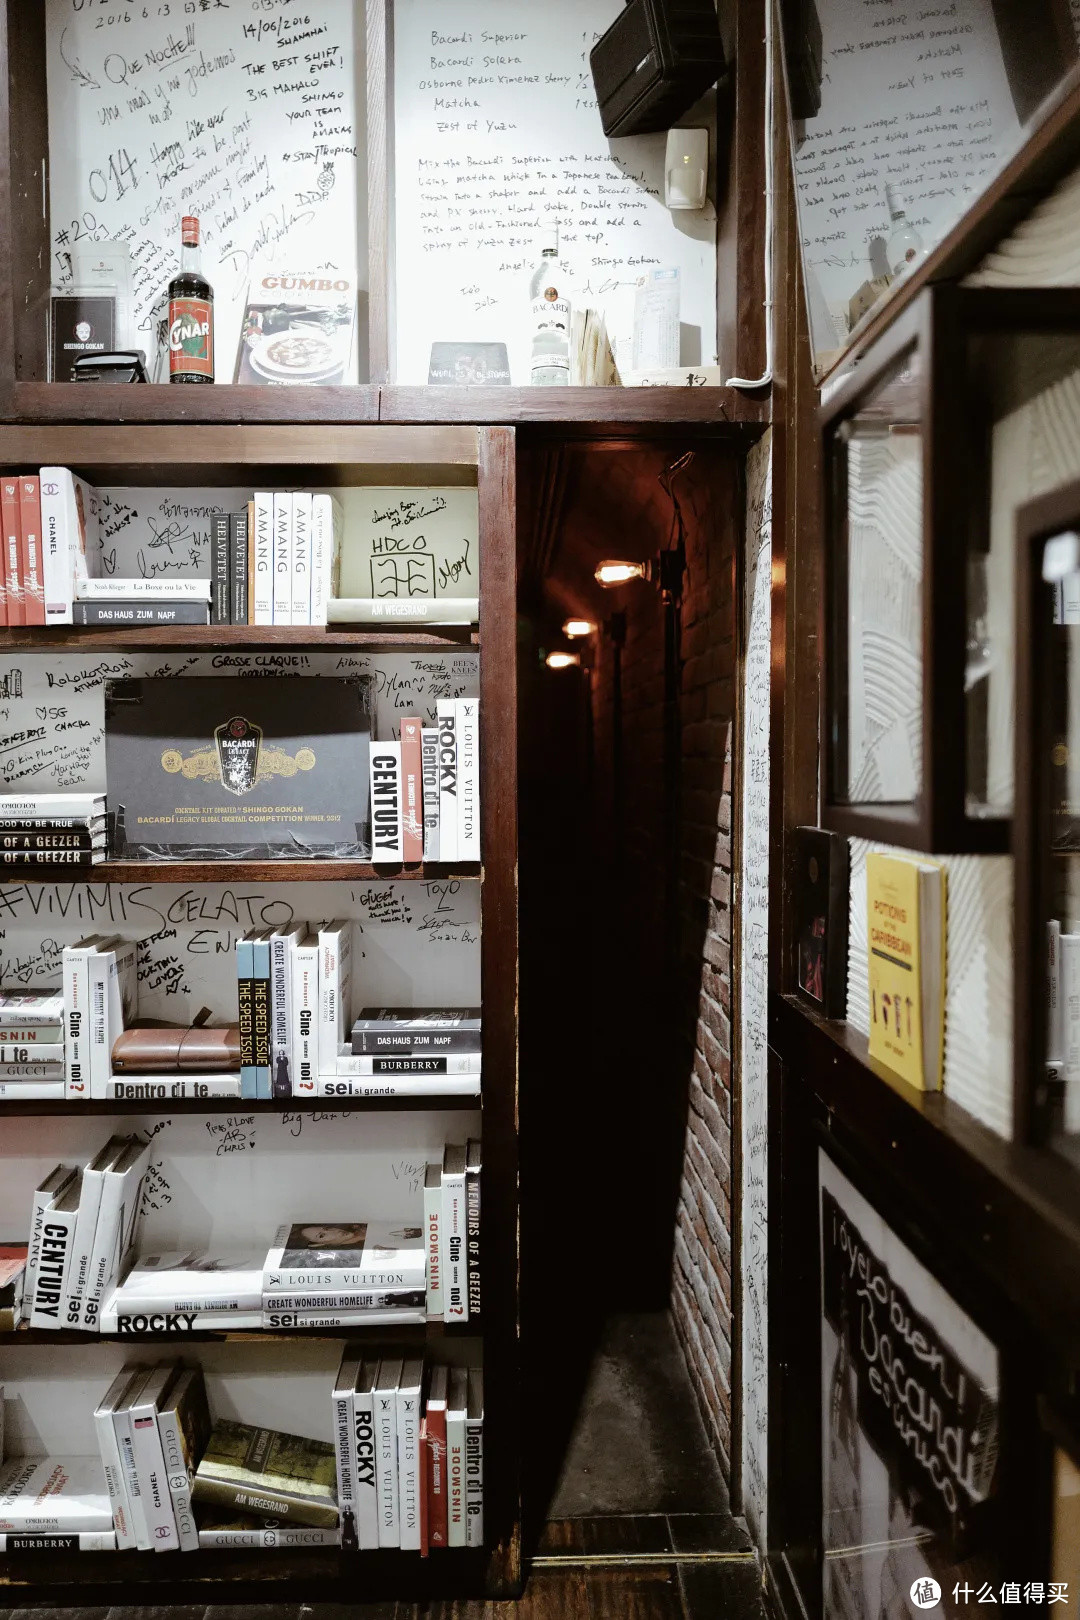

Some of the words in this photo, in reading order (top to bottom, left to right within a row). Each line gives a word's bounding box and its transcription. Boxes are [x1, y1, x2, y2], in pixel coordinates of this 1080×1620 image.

[95, 12, 131, 29] 2016
[243, 16, 311, 41] 14/06/2016
[242, 63, 266, 76] THE
[272, 56, 299, 71] BEST
[304, 46, 340, 63] SHIFT
[246, 89, 268, 101] BIG
[301, 92, 344, 103] SHINGO
[261, 276, 350, 292] GUMBO
[48, 516, 57, 556] CHANEL
[216, 520, 227, 581] HELVETET
[236, 520, 247, 581] HELVETET
[258, 508, 268, 572] AMANG
[277, 508, 288, 573] AMANG
[295, 508, 306, 573] AMANG
[98, 610, 113, 619] DAS
[114, 610, 134, 619] HAUS
[136, 610, 153, 619] ZUM
[157, 611, 176, 620] NAPF
[371, 605, 383, 615] AM
[212, 655, 251, 668] GROSSE
[422, 734, 439, 786] Dentro
[439, 716, 457, 797] ROCKY
[465, 725, 473, 768] LOUIS
[372, 755, 399, 851] CENTURY
[465, 779, 473, 839] VUITTON
[137, 815, 175, 824] BACARDÍ
[4, 837, 18, 847] OF
[23, 837, 31, 847] A
[36, 836, 80, 847] GEEZER
[4, 853, 18, 863] OF
[23, 853, 31, 863] A
[36, 852, 81, 863] GEEZER
[274, 941, 284, 965] CREATE
[239, 981, 251, 1000] THE
[255, 981, 267, 1000] THE
[274, 967, 286, 1011] WONDERFUL
[69, 1011, 81, 1038] Cine
[240, 1002, 252, 1033] SPEED
[256, 1002, 268, 1033] SPEED
[276, 1011, 287, 1046] HOMELIFE
[299, 1009, 312, 1036] Cine
[13, 1046, 28, 1062] te
[241, 1036, 253, 1065] ISSUE
[257, 1036, 269, 1065] ISSUE
[377, 1037, 391, 1045] DAS
[392, 1036, 411, 1045] HAUS
[413, 1036, 430, 1044] ZUM
[433, 1036, 451, 1045] NAPF
[7, 1067, 46, 1076] GUCCI
[380, 1061, 439, 1070] BURBERRY
[115, 1083, 166, 1099] Dentro
[172, 1083, 186, 1098] di
[194, 1083, 209, 1098] te
[325, 1080, 353, 1095] sei
[364, 1086, 396, 1096] grande
[468, 1182, 480, 1236] MEMOIRS
[29, 1206, 45, 1268] AMANG
[429, 1212, 439, 1290] NINSMODE
[449, 1236, 461, 1262] Cine
[469, 1242, 479, 1255] OF
[35, 1223, 68, 1318] CENTURY
[288, 1275, 332, 1285] LOUIS
[343, 1274, 404, 1283] VUITTON
[67, 1295, 81, 1323] sei
[79, 1255, 88, 1286] grande
[85, 1296, 100, 1325] sei
[96, 1257, 107, 1288] grande
[267, 1299, 293, 1309] CREATE
[294, 1297, 337, 1308] WONDERFUL
[339, 1295, 373, 1306] HOMELIFE
[469, 1271, 481, 1314] GEEZER
[117, 1314, 198, 1332] ROCKY
[269, 1312, 298, 1327] sei
[309, 1317, 341, 1327] grande
[337, 1400, 347, 1422] CREATE
[165, 1429, 180, 1468] GUCCI
[338, 1424, 351, 1467] WONDERFUL
[355, 1410, 375, 1487] ROCKY
[381, 1417, 391, 1459] LOUIS
[404, 1419, 414, 1460] LOUIS
[466, 1425, 483, 1475] Dentro
[150, 1471, 161, 1508] CHANEL
[341, 1467, 352, 1501] HOMELIFE
[452, 1446, 461, 1523] NINSMODE
[235, 1493, 247, 1504] AM
[248, 1496, 289, 1514] WEGESRAND
[382, 1470, 393, 1528] VUITTON
[405, 1471, 416, 1529] VUITTON
[13, 1539, 73, 1549] BURBERRY
[215, 1535, 254, 1545] GUCCI
[286, 1533, 324, 1544] GUCCI
